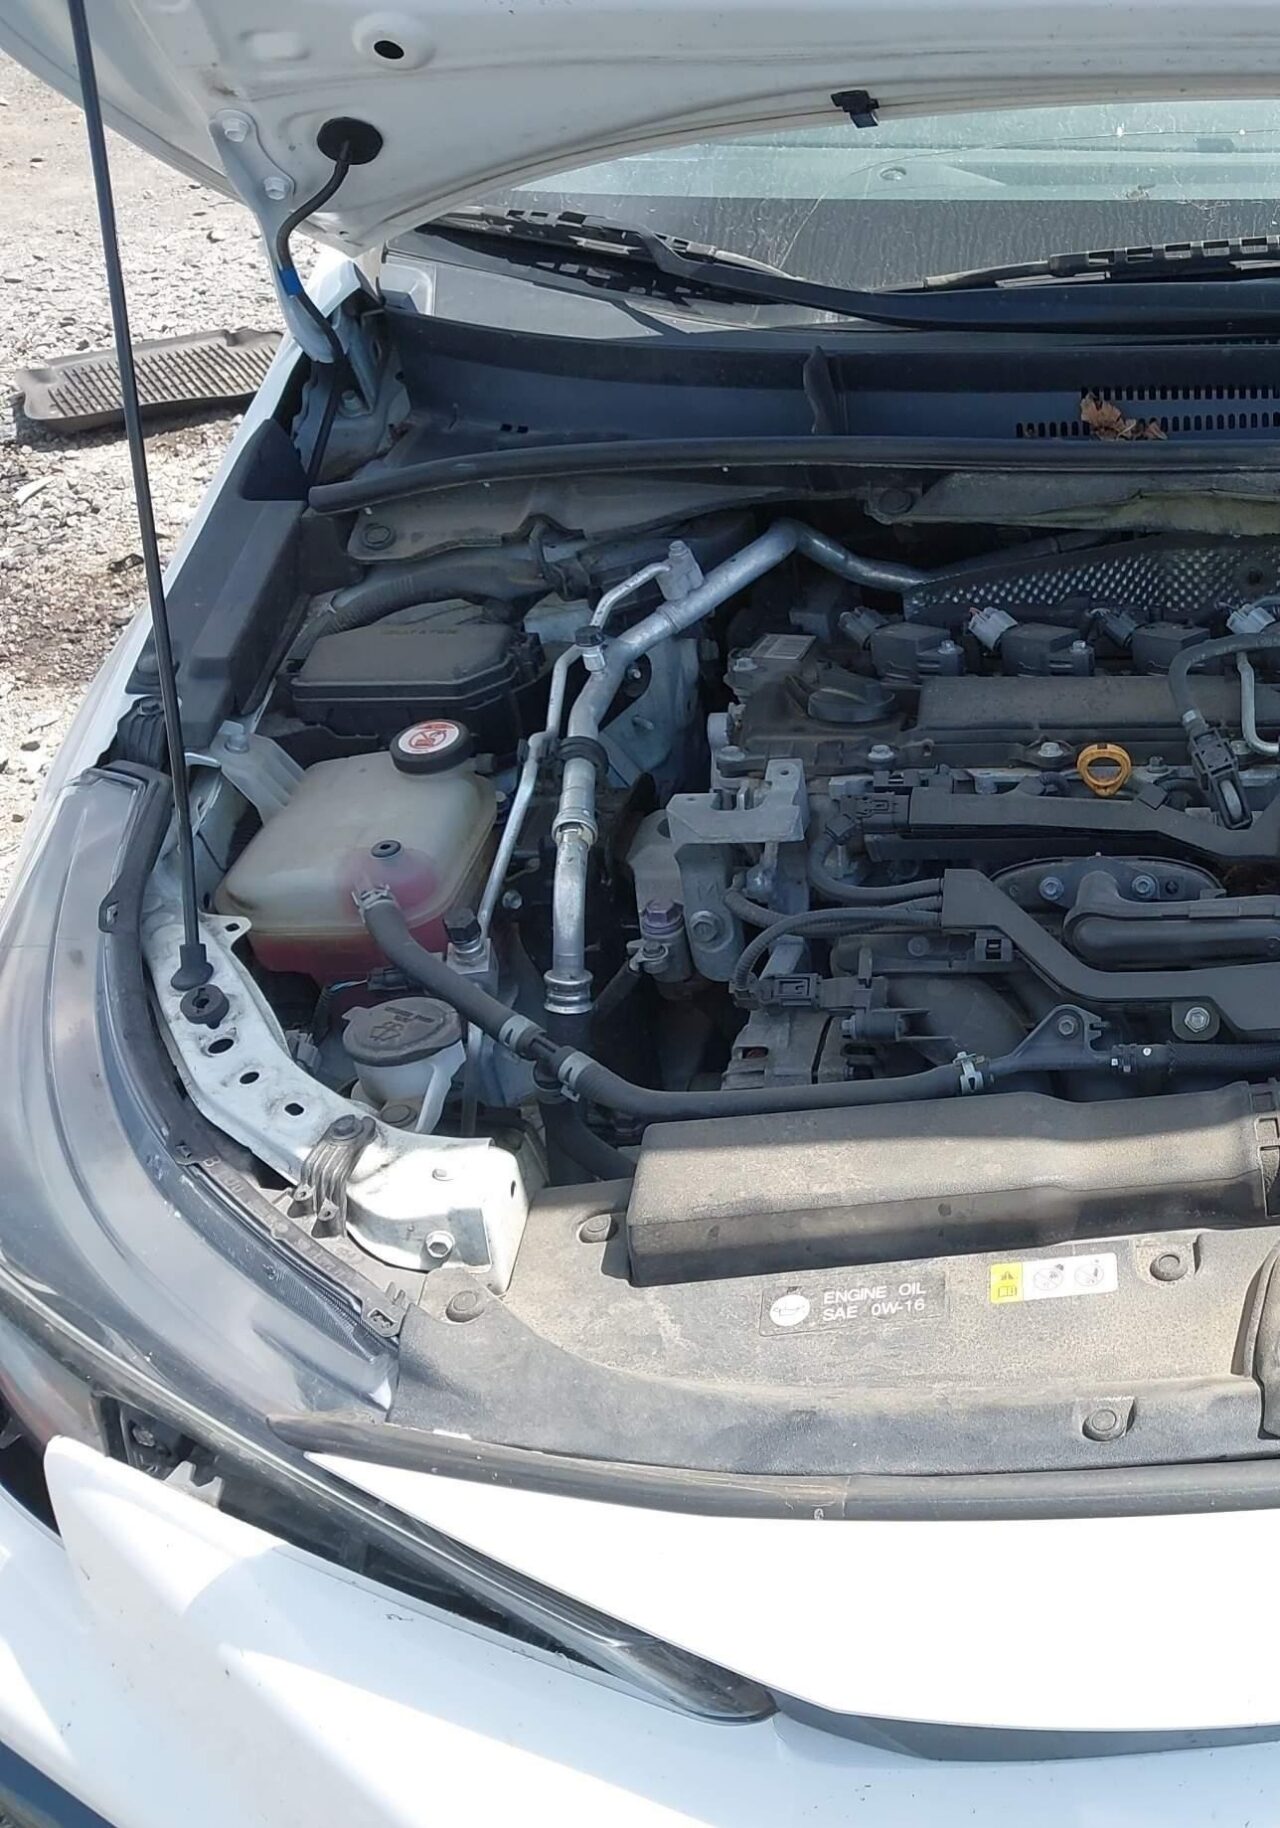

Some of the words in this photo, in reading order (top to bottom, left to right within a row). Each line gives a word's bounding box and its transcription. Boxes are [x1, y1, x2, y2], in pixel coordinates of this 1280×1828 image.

[823, 1285, 888, 1305] ENGINE
[898, 1281, 927, 1297] OIL
[822, 1305, 858, 1322] SAE
[871, 1297, 925, 1316] 0W-16
